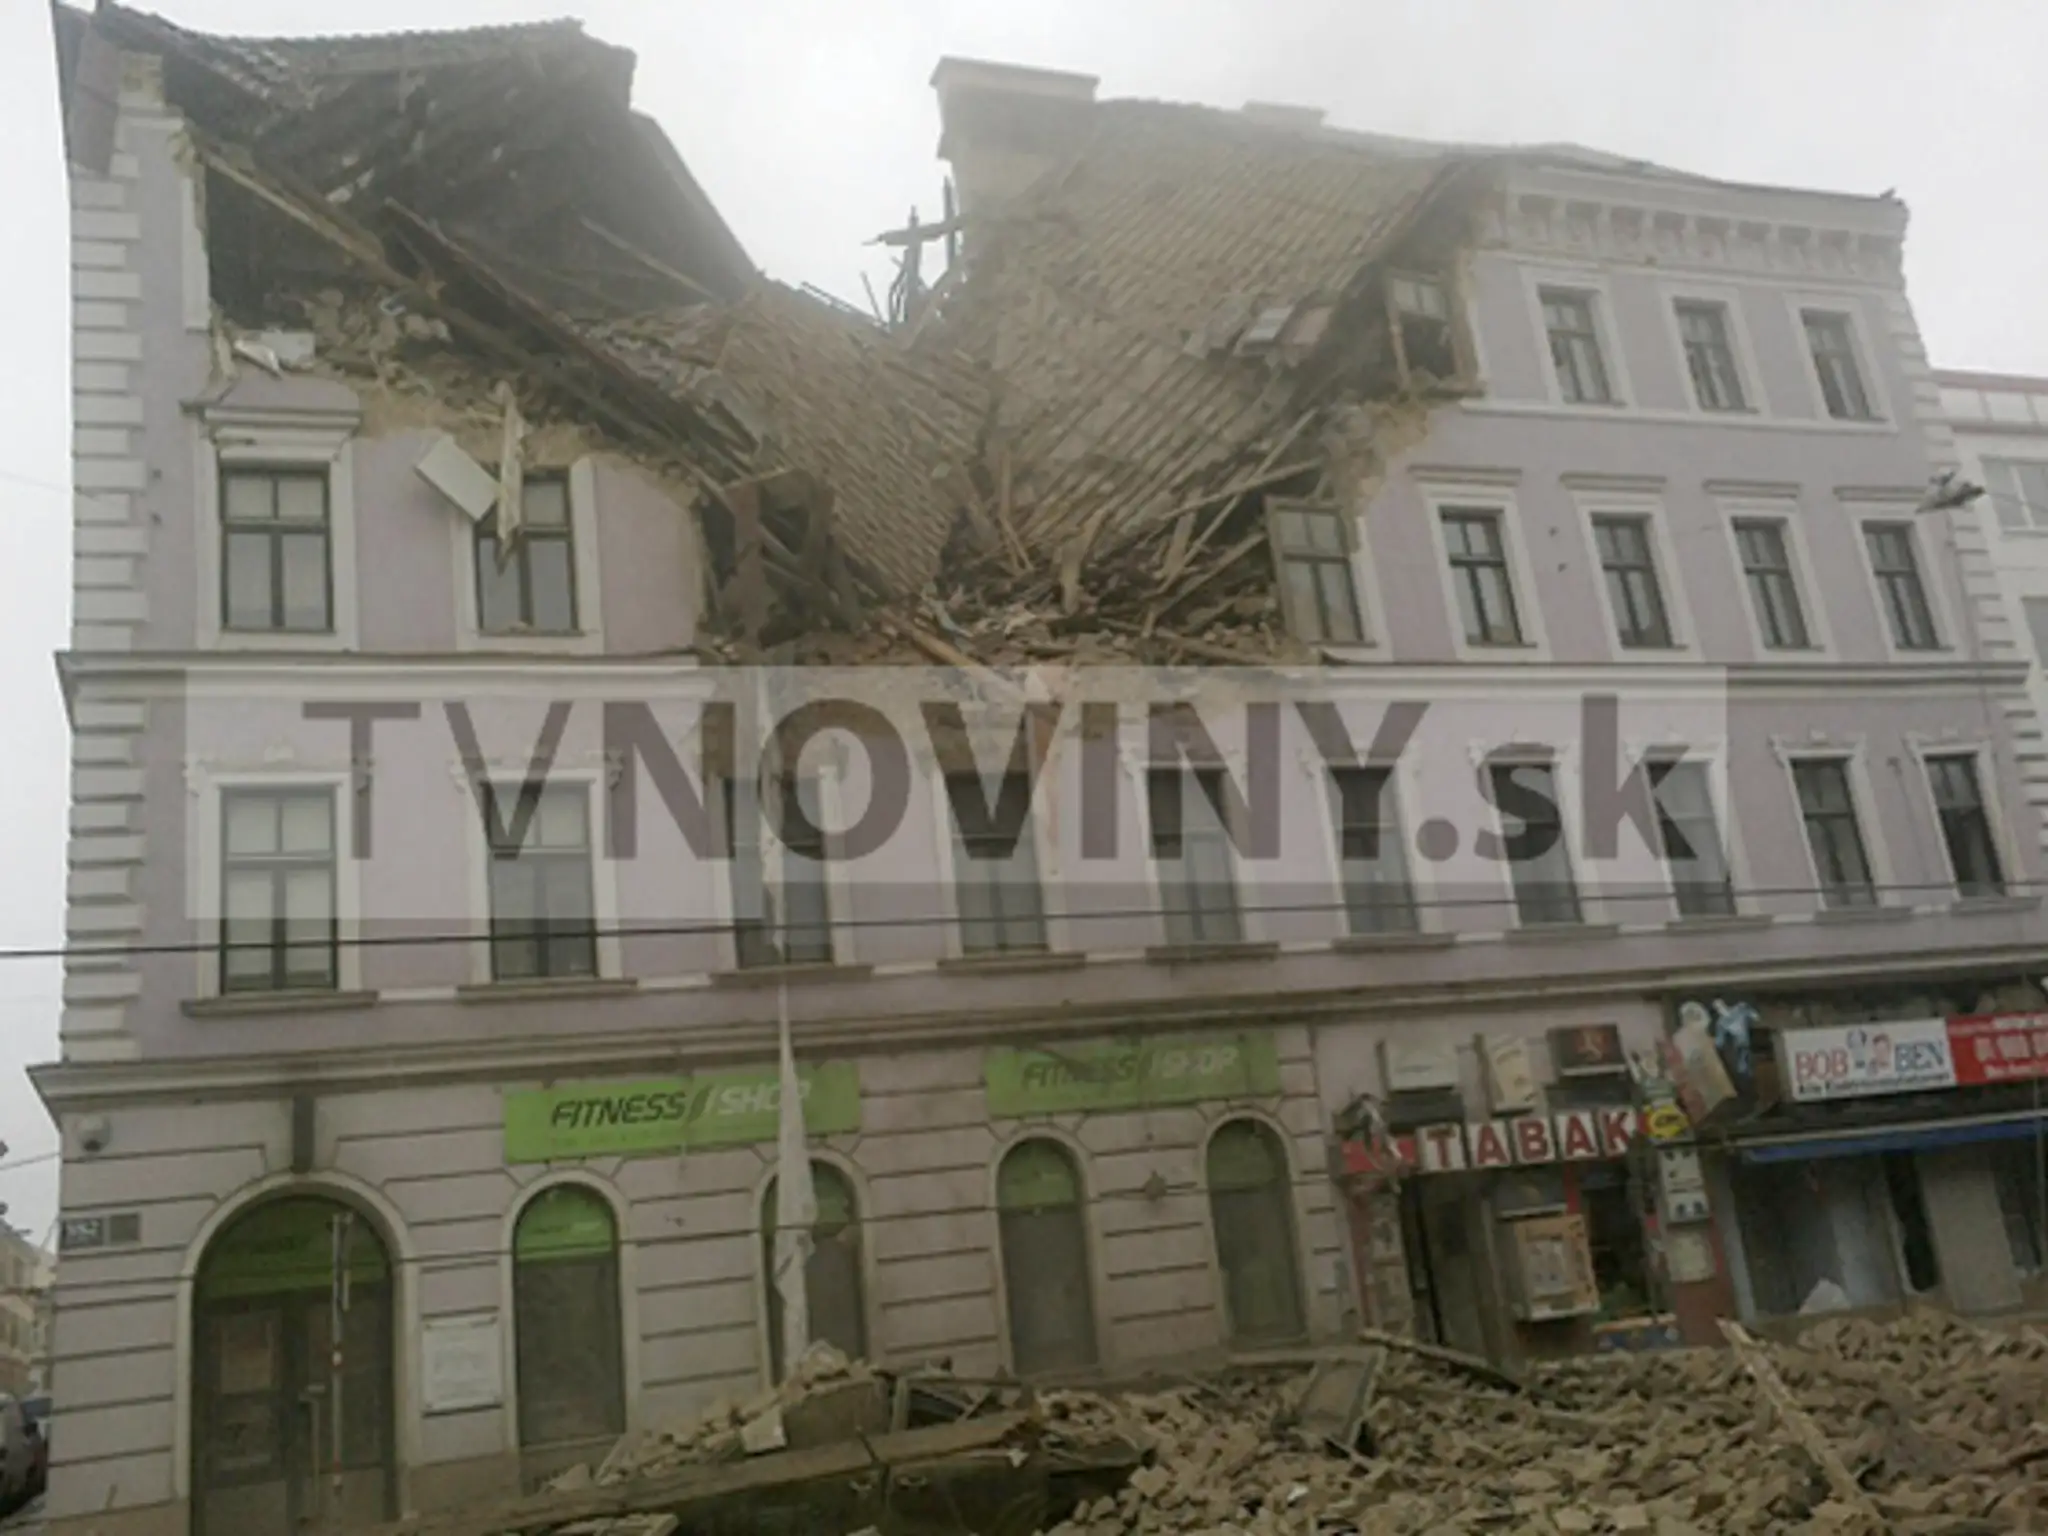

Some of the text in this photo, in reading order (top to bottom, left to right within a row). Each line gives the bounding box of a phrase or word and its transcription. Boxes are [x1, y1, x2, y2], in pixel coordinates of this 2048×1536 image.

[1795, 1048, 1849, 1080] BOB
[1894, 1040, 1946, 1072] BEN
[550, 1091, 687, 1129] FITNESS
[1427, 1107, 1633, 1170] TABAK
